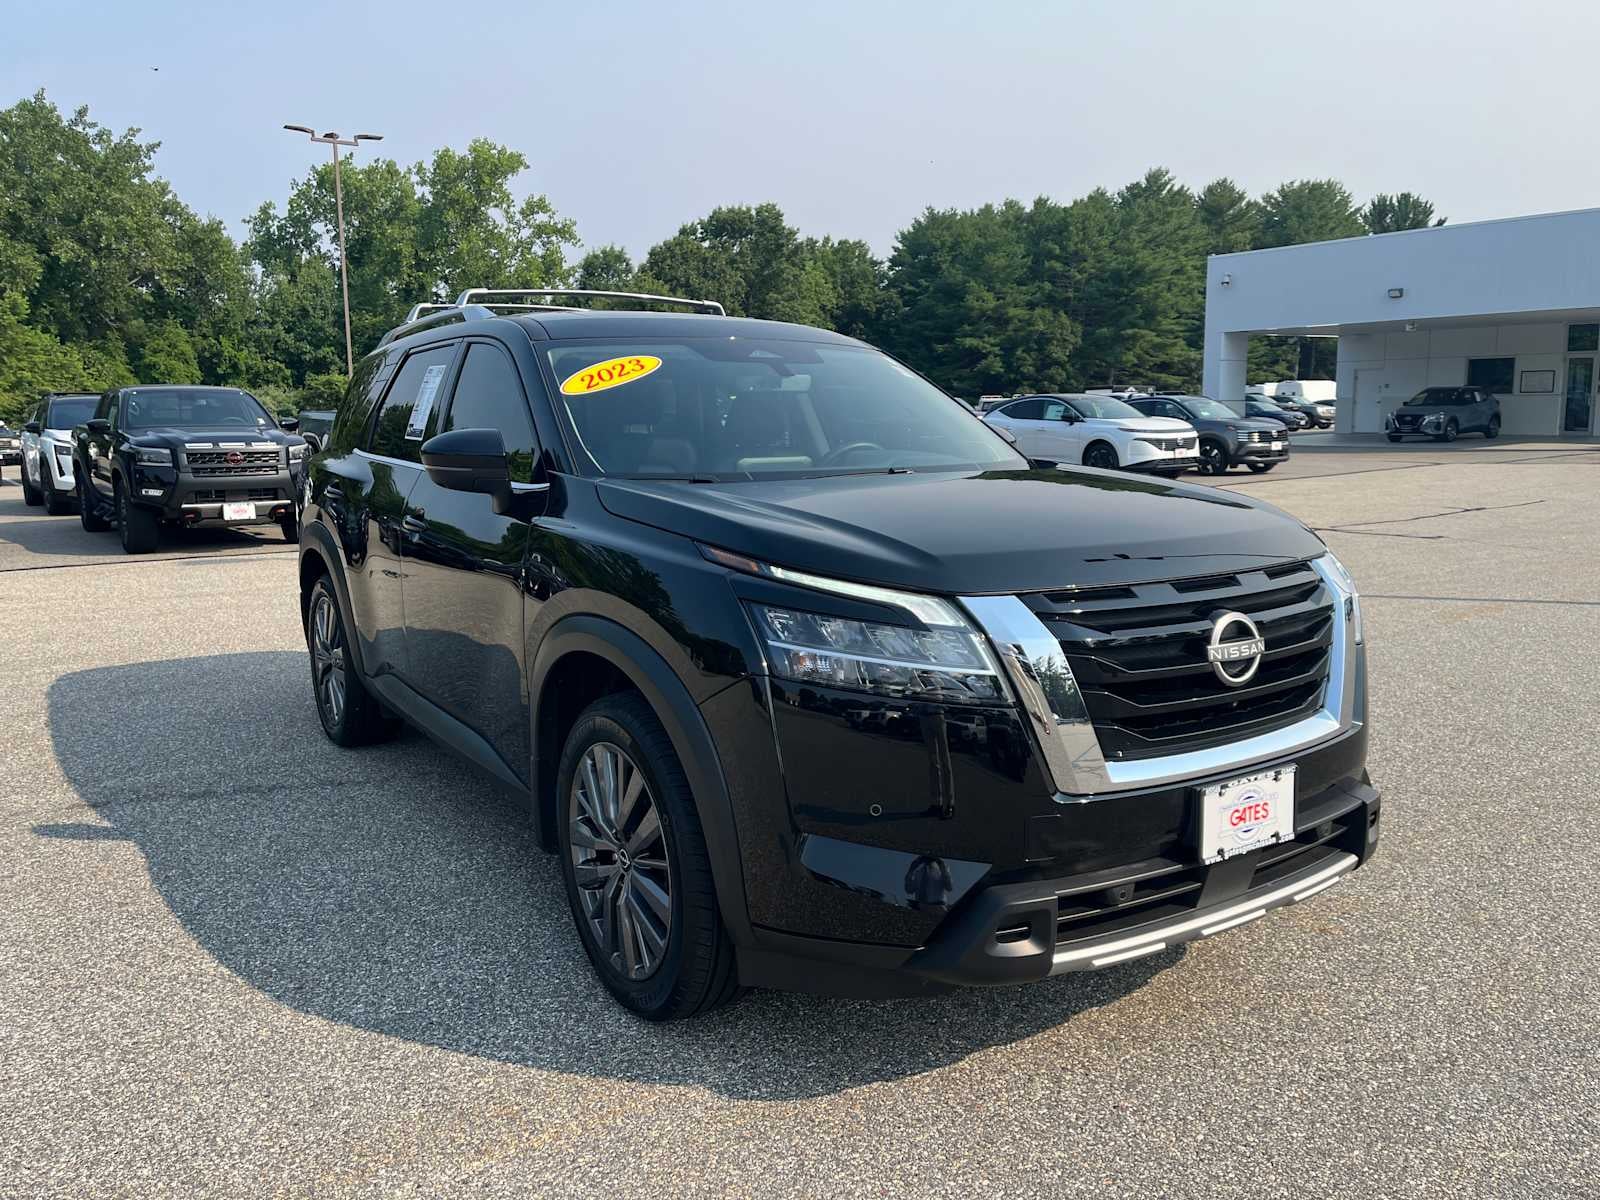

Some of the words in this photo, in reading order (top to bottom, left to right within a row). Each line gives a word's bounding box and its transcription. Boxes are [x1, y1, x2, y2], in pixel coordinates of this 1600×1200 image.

[580, 359, 645, 390] 2023
[1210, 640, 1265, 660] NISSAN
[1230, 802, 1269, 827] GATES
